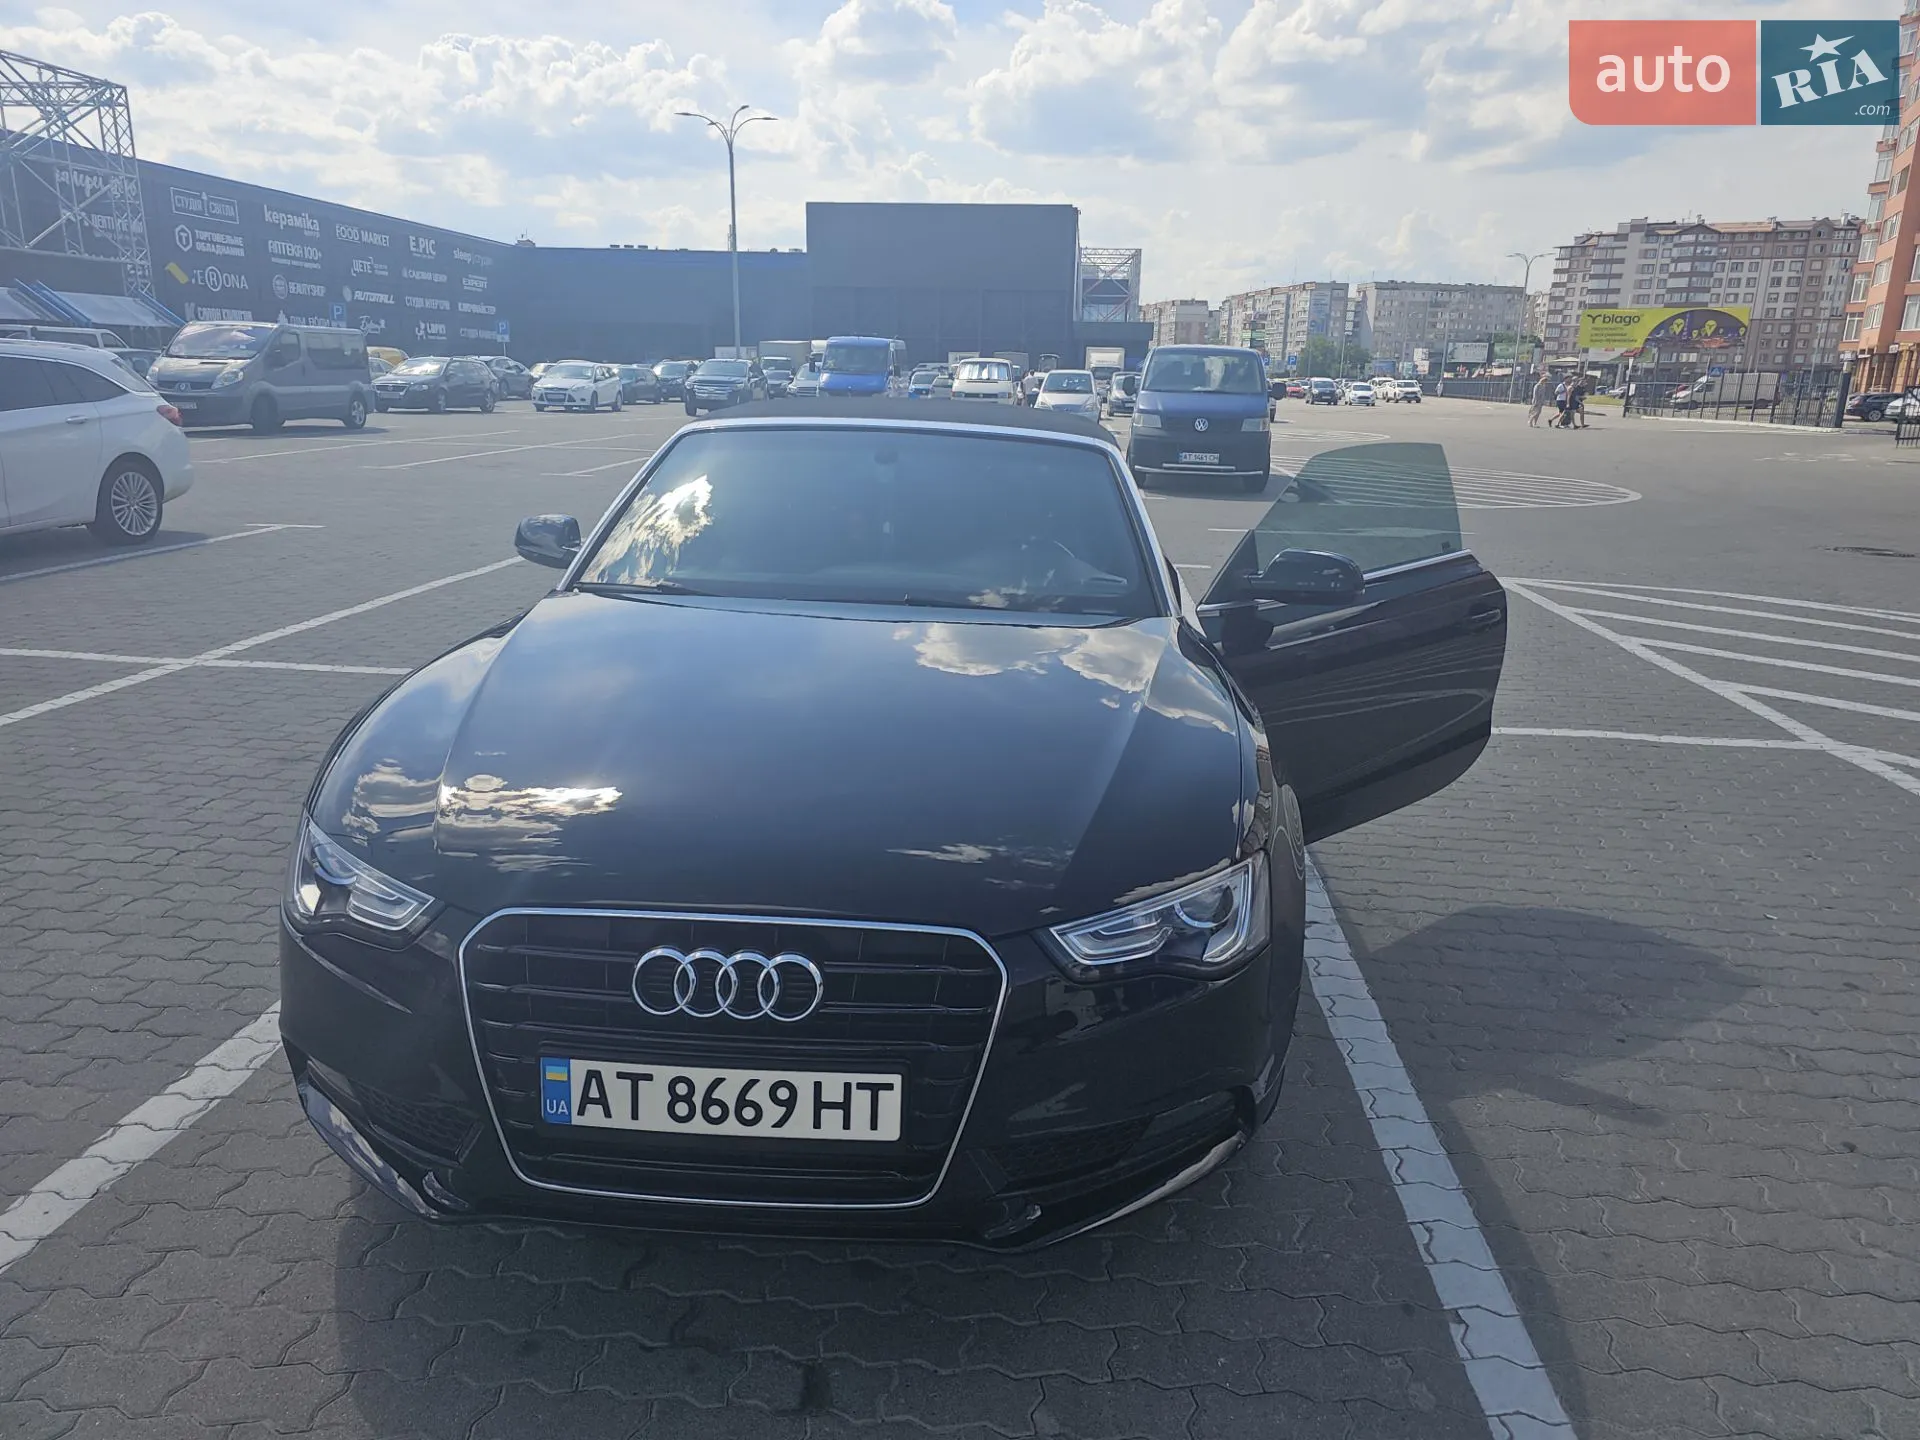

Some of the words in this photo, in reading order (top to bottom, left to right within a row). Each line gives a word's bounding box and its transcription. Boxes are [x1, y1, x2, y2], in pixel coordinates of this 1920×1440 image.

[335, 223, 360, 241] FOOD
[360, 230, 390, 247] MARKET
[546, 1099, 569, 1116] UA
[576, 1069, 654, 1121] AT
[666, 1075, 798, 1129] 8669
[812, 1080, 895, 1131] HT
